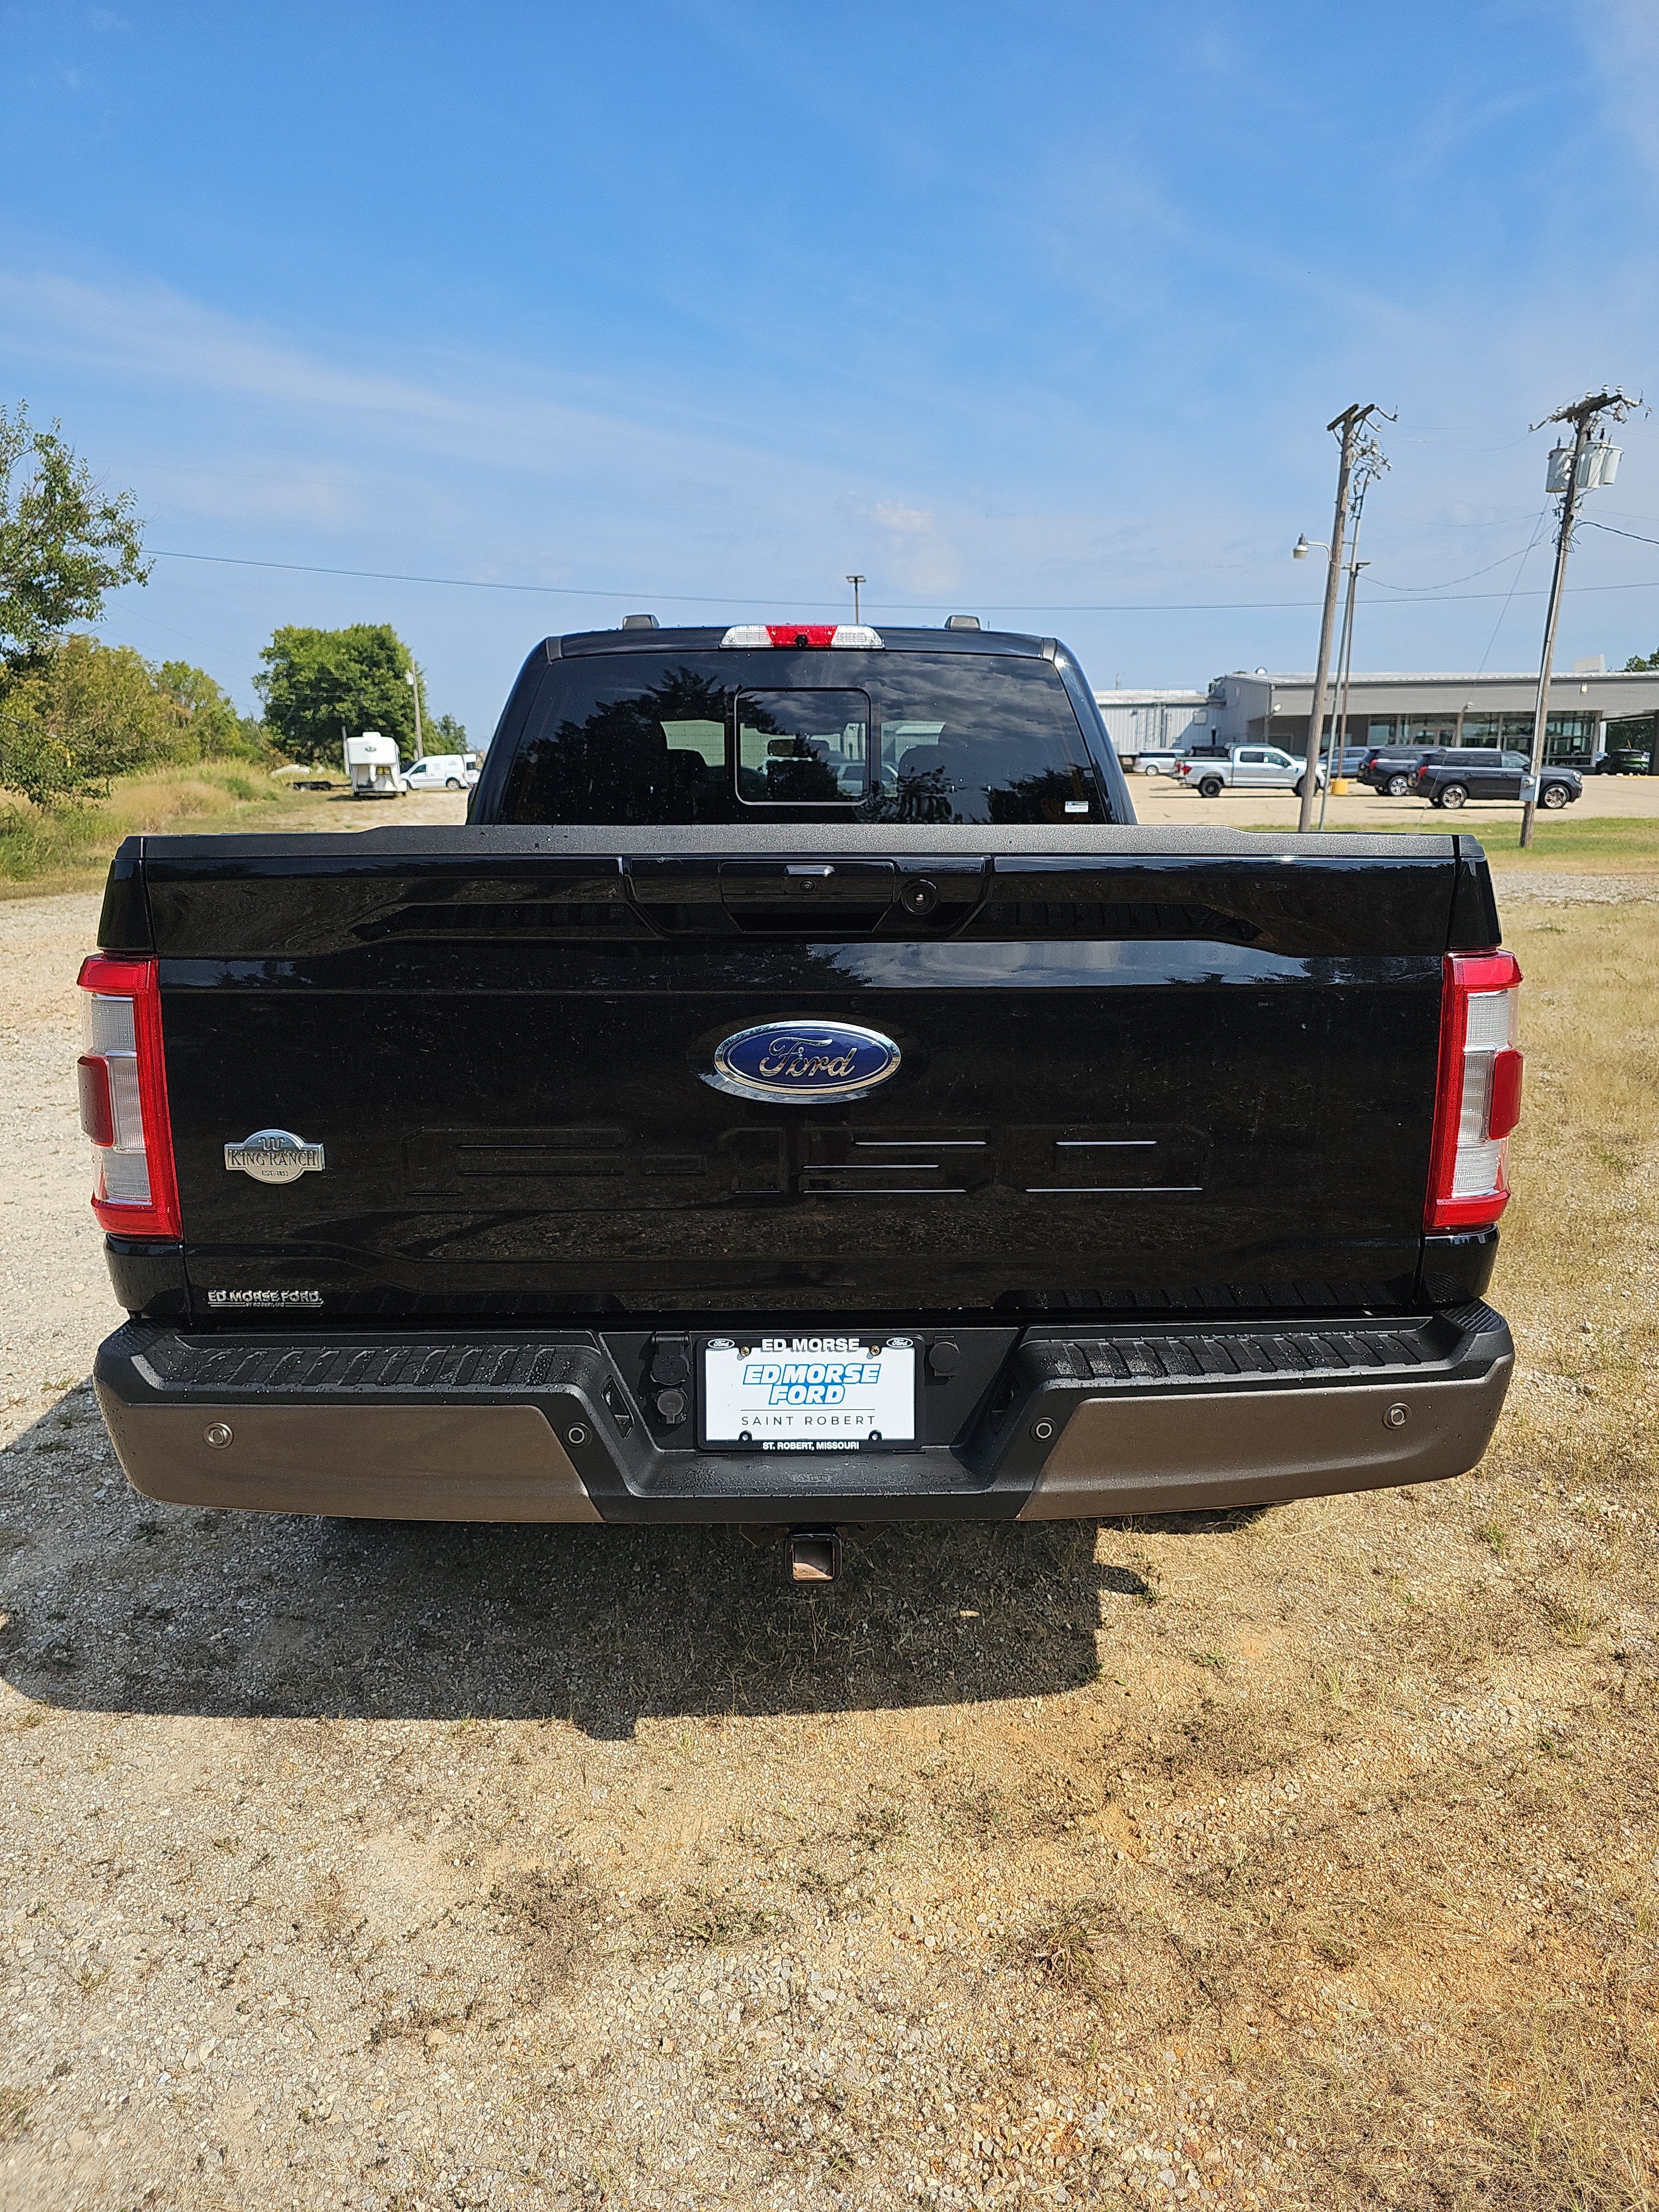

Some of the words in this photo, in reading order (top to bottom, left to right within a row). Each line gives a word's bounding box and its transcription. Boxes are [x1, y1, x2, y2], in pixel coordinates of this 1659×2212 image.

[759, 1036, 858, 1077] Ford
[229, 1150, 265, 1166] KING
[267, 1150, 317, 1166] RANCH
[208, 1290, 227, 1302] ED
[229, 1290, 280, 1302] MORSE
[762, 1339, 787, 1351] ED
[792, 1339, 860, 1351] MORSE
[743, 1364, 781, 1385] ED
[779, 1364, 882, 1384] MORSE
[768, 1385, 846, 1405] FORD
[741, 1416, 795, 1425] SAINT
[805, 1415, 876, 1425] ROBERT
[762, 1442, 776, 1450] ST.
[777, 1442, 814, 1451] ROBERT,
[816, 1441, 859, 1450] MISSOURI
